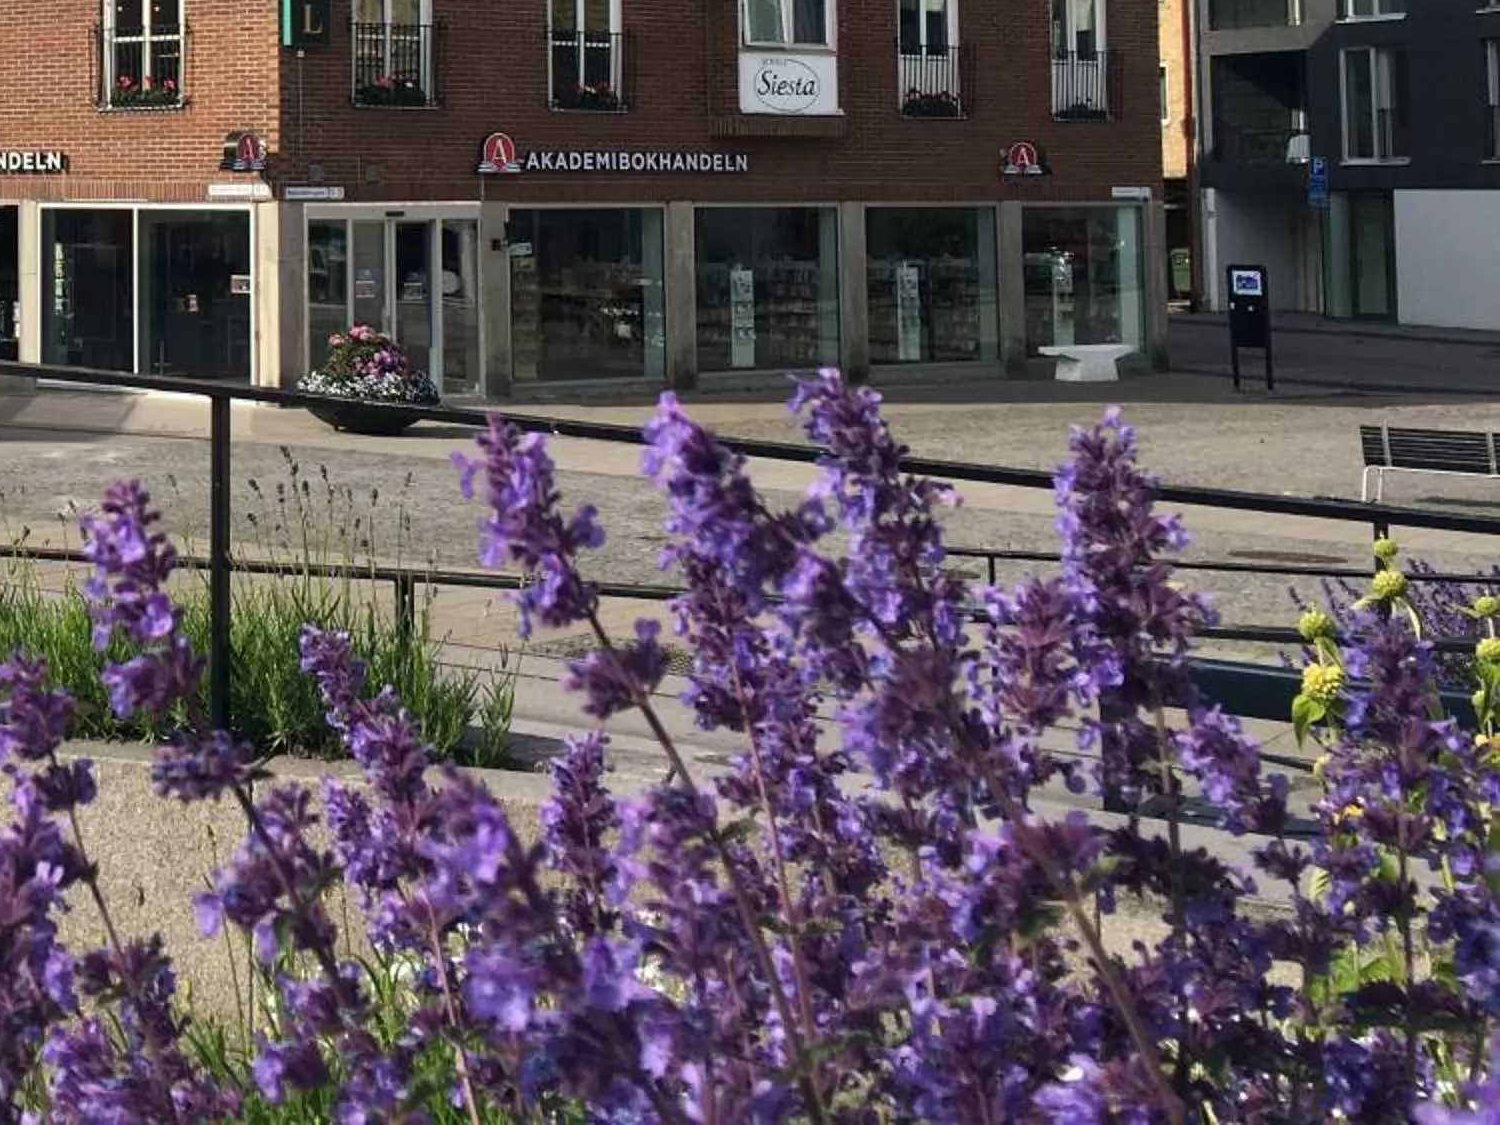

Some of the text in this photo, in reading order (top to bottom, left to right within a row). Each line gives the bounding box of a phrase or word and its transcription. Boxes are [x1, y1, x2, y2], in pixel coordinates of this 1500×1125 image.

[757, 69, 815, 96] Siesta
[491, 138, 749, 172] A AKADEMIBOKHANDELN
